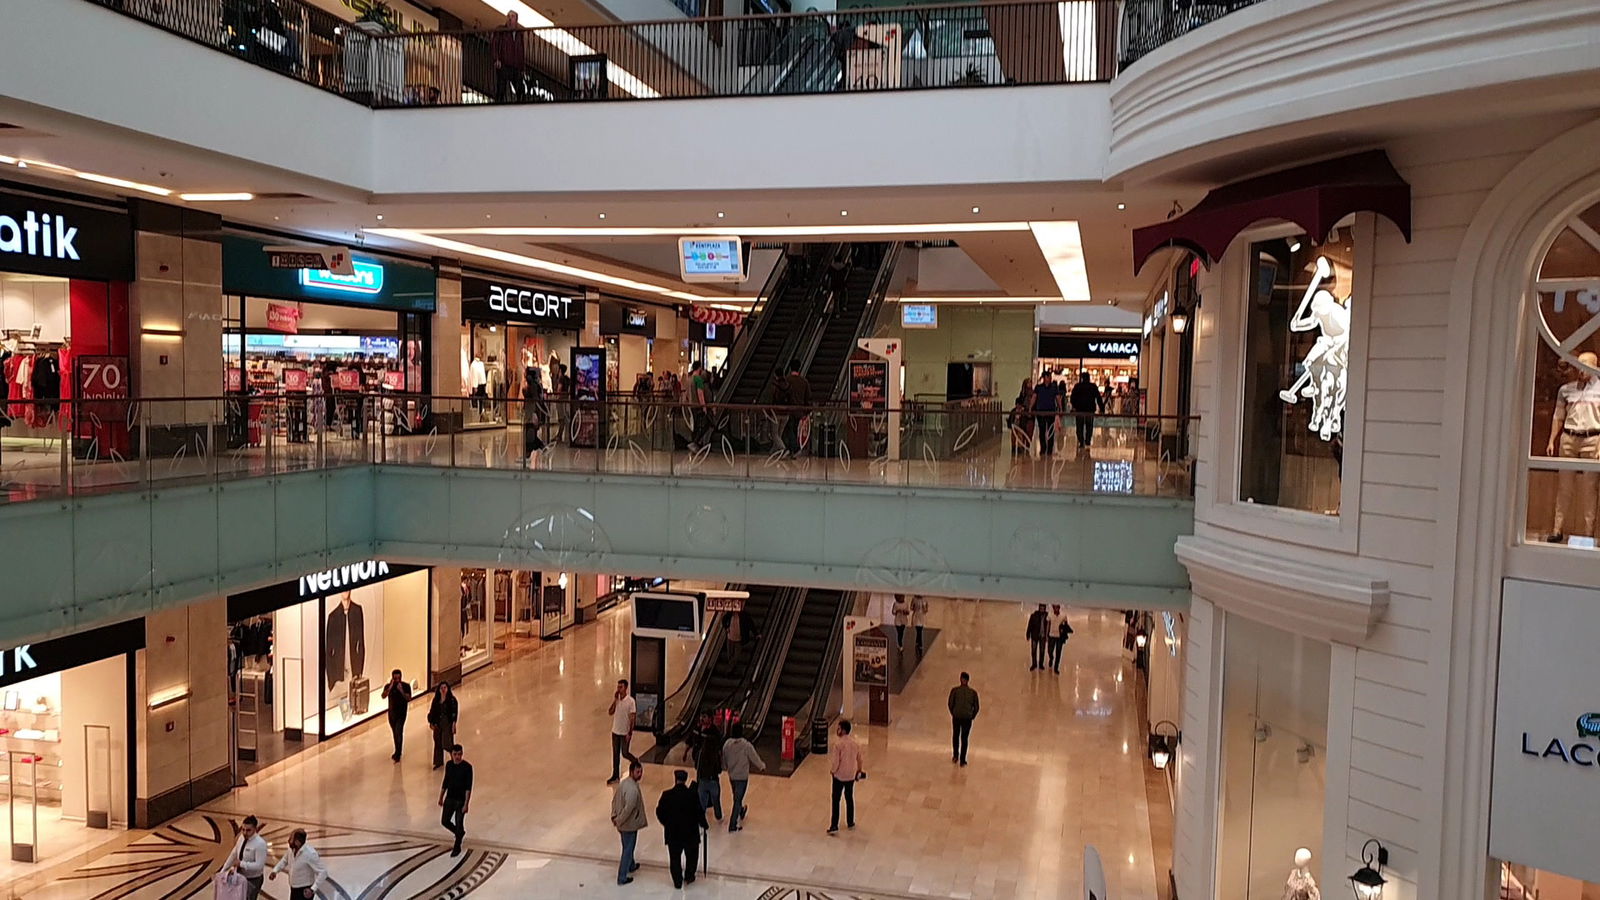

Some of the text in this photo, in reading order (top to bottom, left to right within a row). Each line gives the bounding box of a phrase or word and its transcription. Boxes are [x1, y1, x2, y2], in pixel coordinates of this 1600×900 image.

[0, 210, 80, 260] atik
[1100, 342, 1138, 354] KARACA
[82, 363, 120, 389] 70
[1522, 731, 1600, 767] LAC
